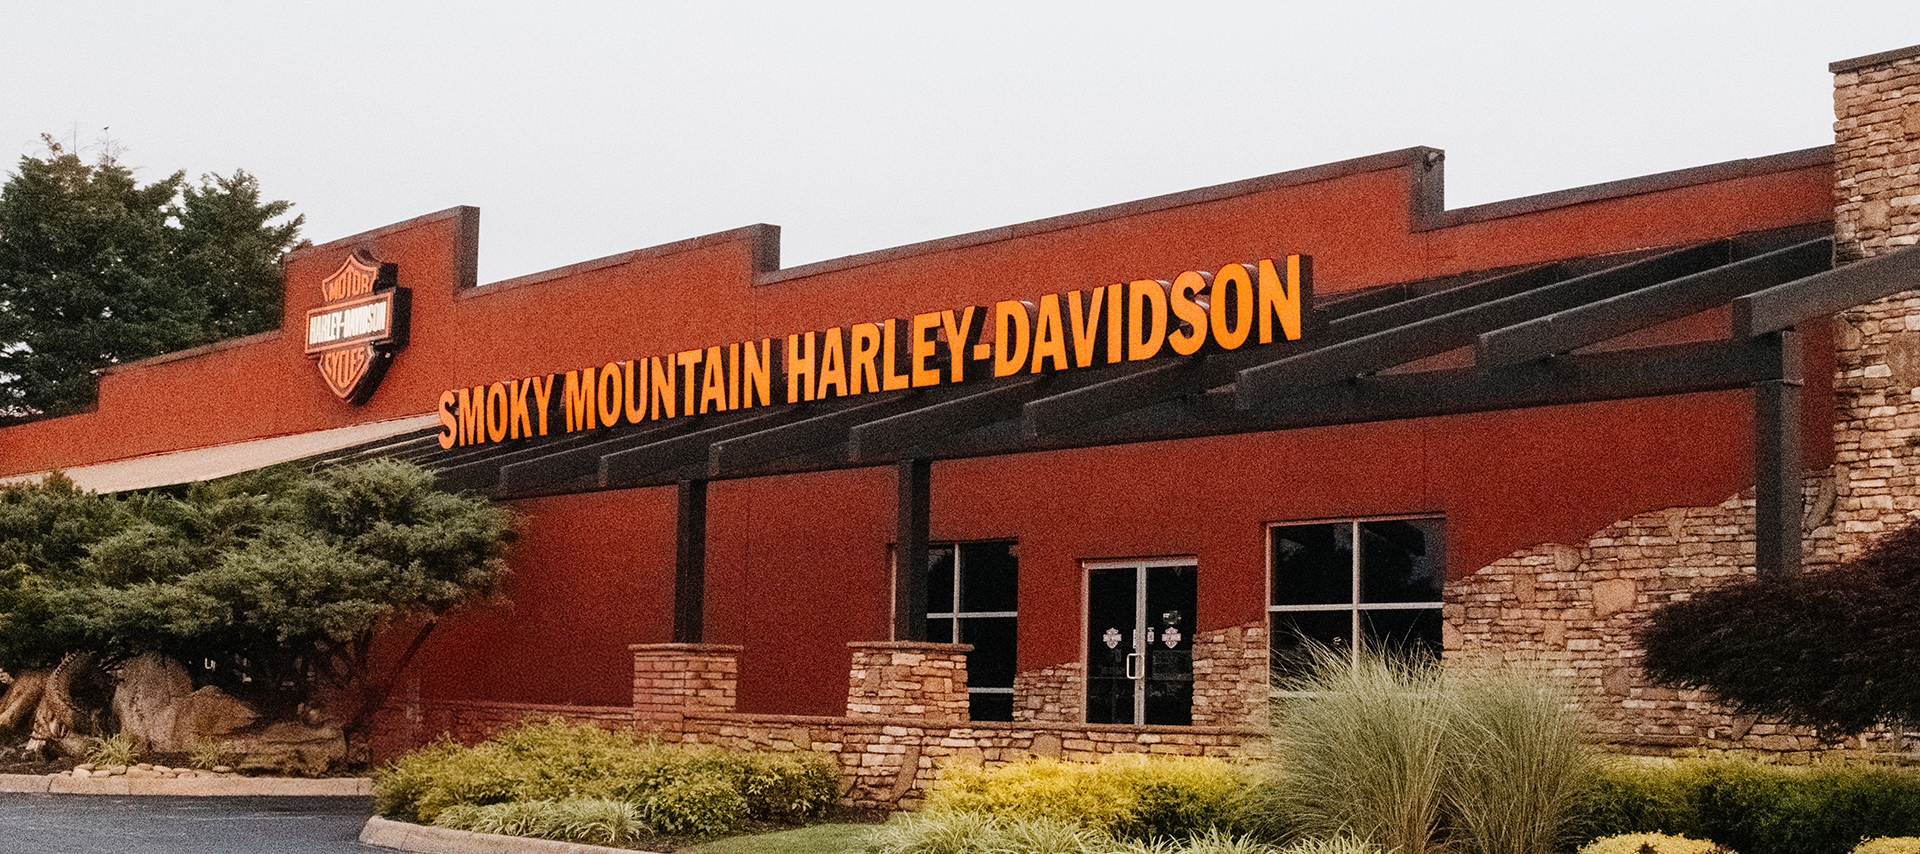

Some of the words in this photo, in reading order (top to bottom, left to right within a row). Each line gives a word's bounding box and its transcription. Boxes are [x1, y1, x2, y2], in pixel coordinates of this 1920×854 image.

[329, 264, 369, 301] MOTOR
[309, 301, 387, 345] HARLEY-DAVIDSON
[325, 347, 365, 389] CYCLES
[438, 373, 554, 449] SMOKY
[564, 338, 771, 433] MOUNTAIN
[787, 254, 1301, 403] HARLEY-DAVIDSON
